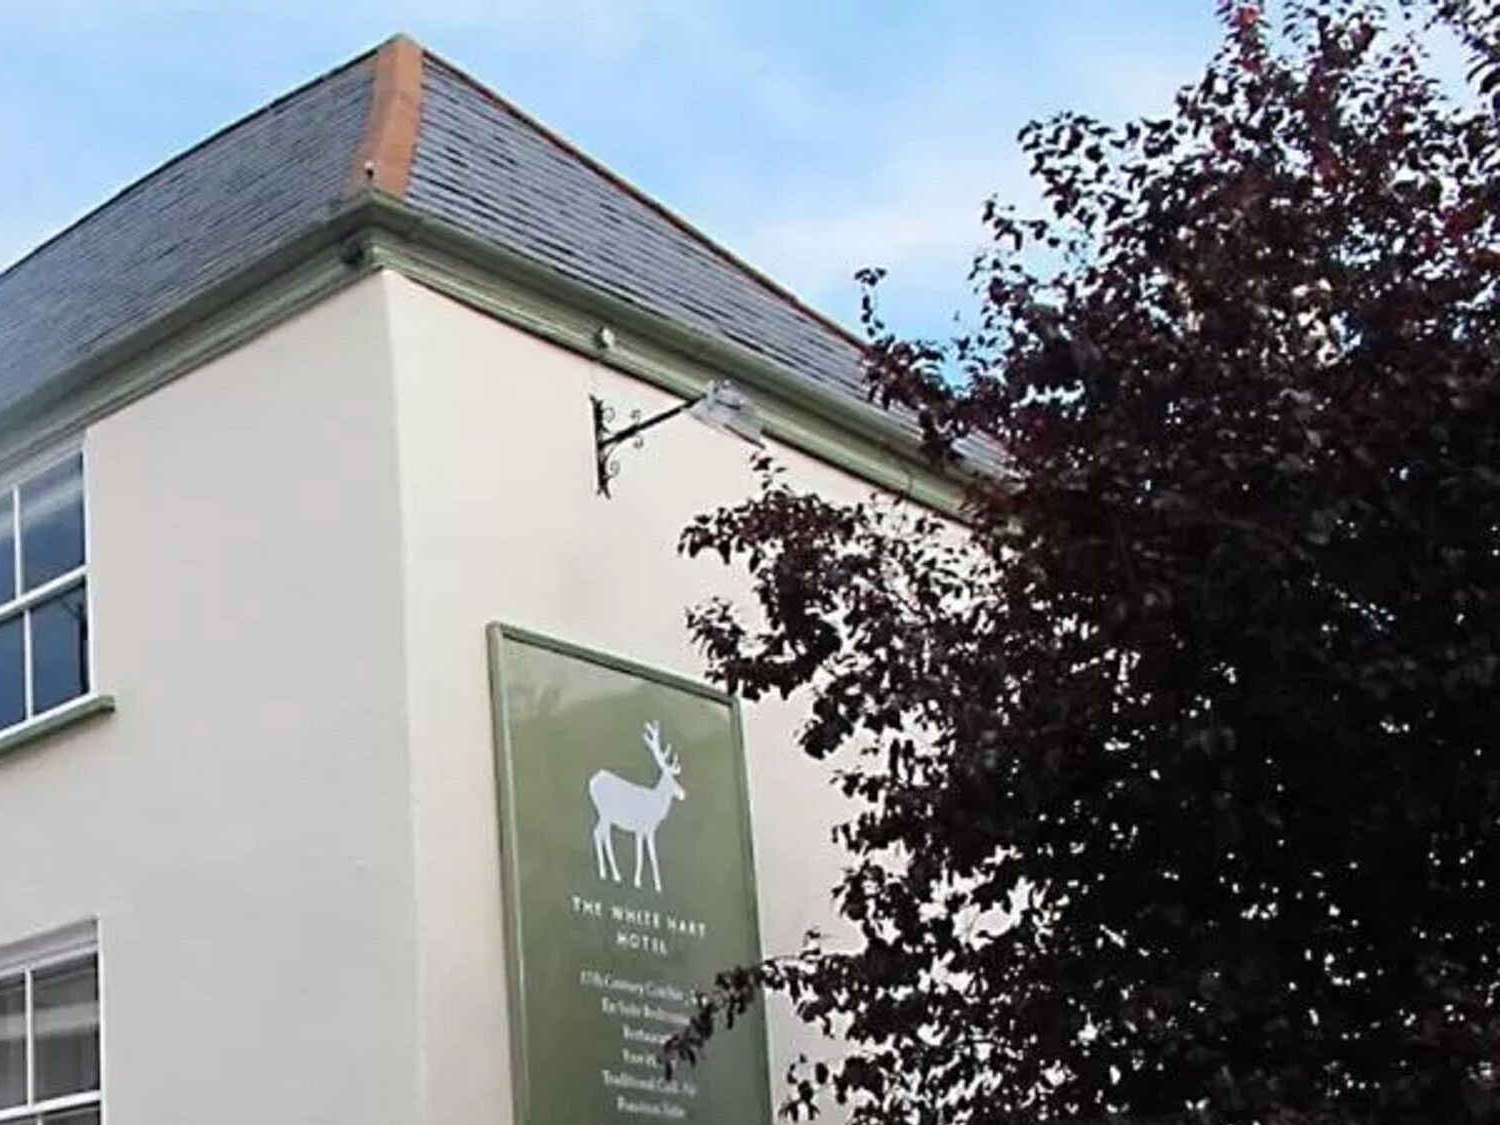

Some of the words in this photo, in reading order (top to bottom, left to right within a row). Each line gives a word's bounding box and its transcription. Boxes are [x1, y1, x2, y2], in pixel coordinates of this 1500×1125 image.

[573, 896, 602, 917] THE
[611, 906, 660, 929] WHITE
[666, 916, 706, 937] HART
[616, 931, 668, 956] HOTEL
